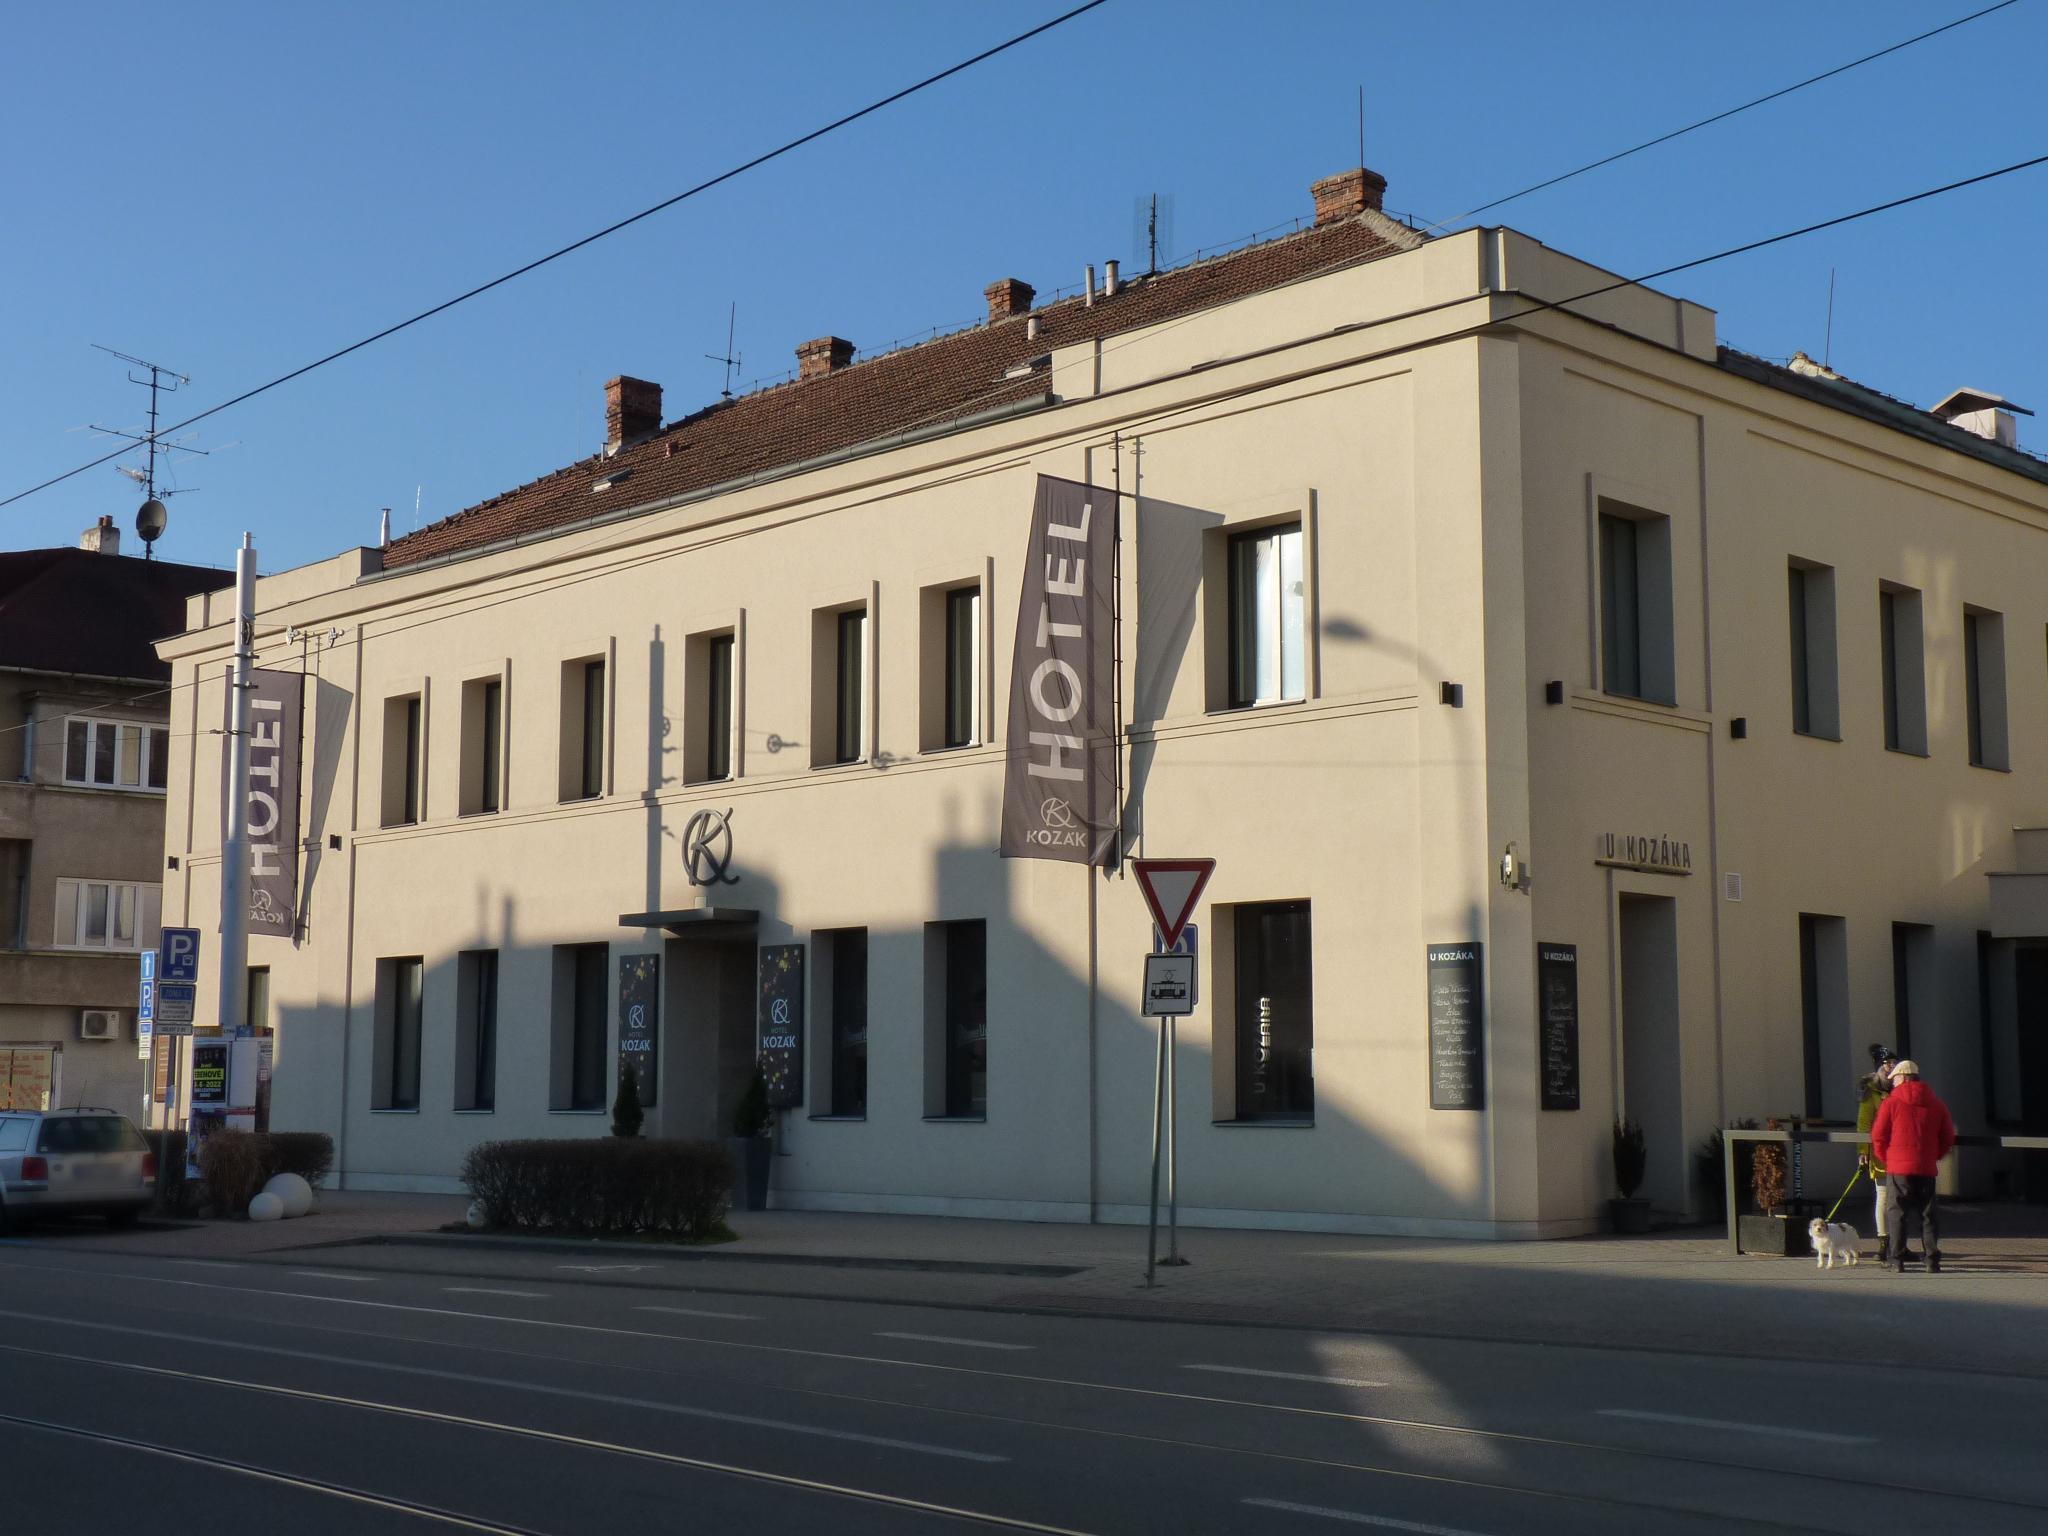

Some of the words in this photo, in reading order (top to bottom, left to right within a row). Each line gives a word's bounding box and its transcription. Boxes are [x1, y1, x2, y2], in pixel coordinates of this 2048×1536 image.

[1027, 503, 1093, 782] HOTEL
[1026, 829, 1087, 848] KOZÁK
[1605, 832, 1615, 859] U
[1626, 833, 1691, 868] KOZÁKA
[170, 935, 193, 965] P
[1430, 952, 1436, 961] U
[1438, 950, 1474, 961] KOZÁKA
[1544, 952, 1550, 960] U
[1550, 951, 1575, 962] KOZÁKA
